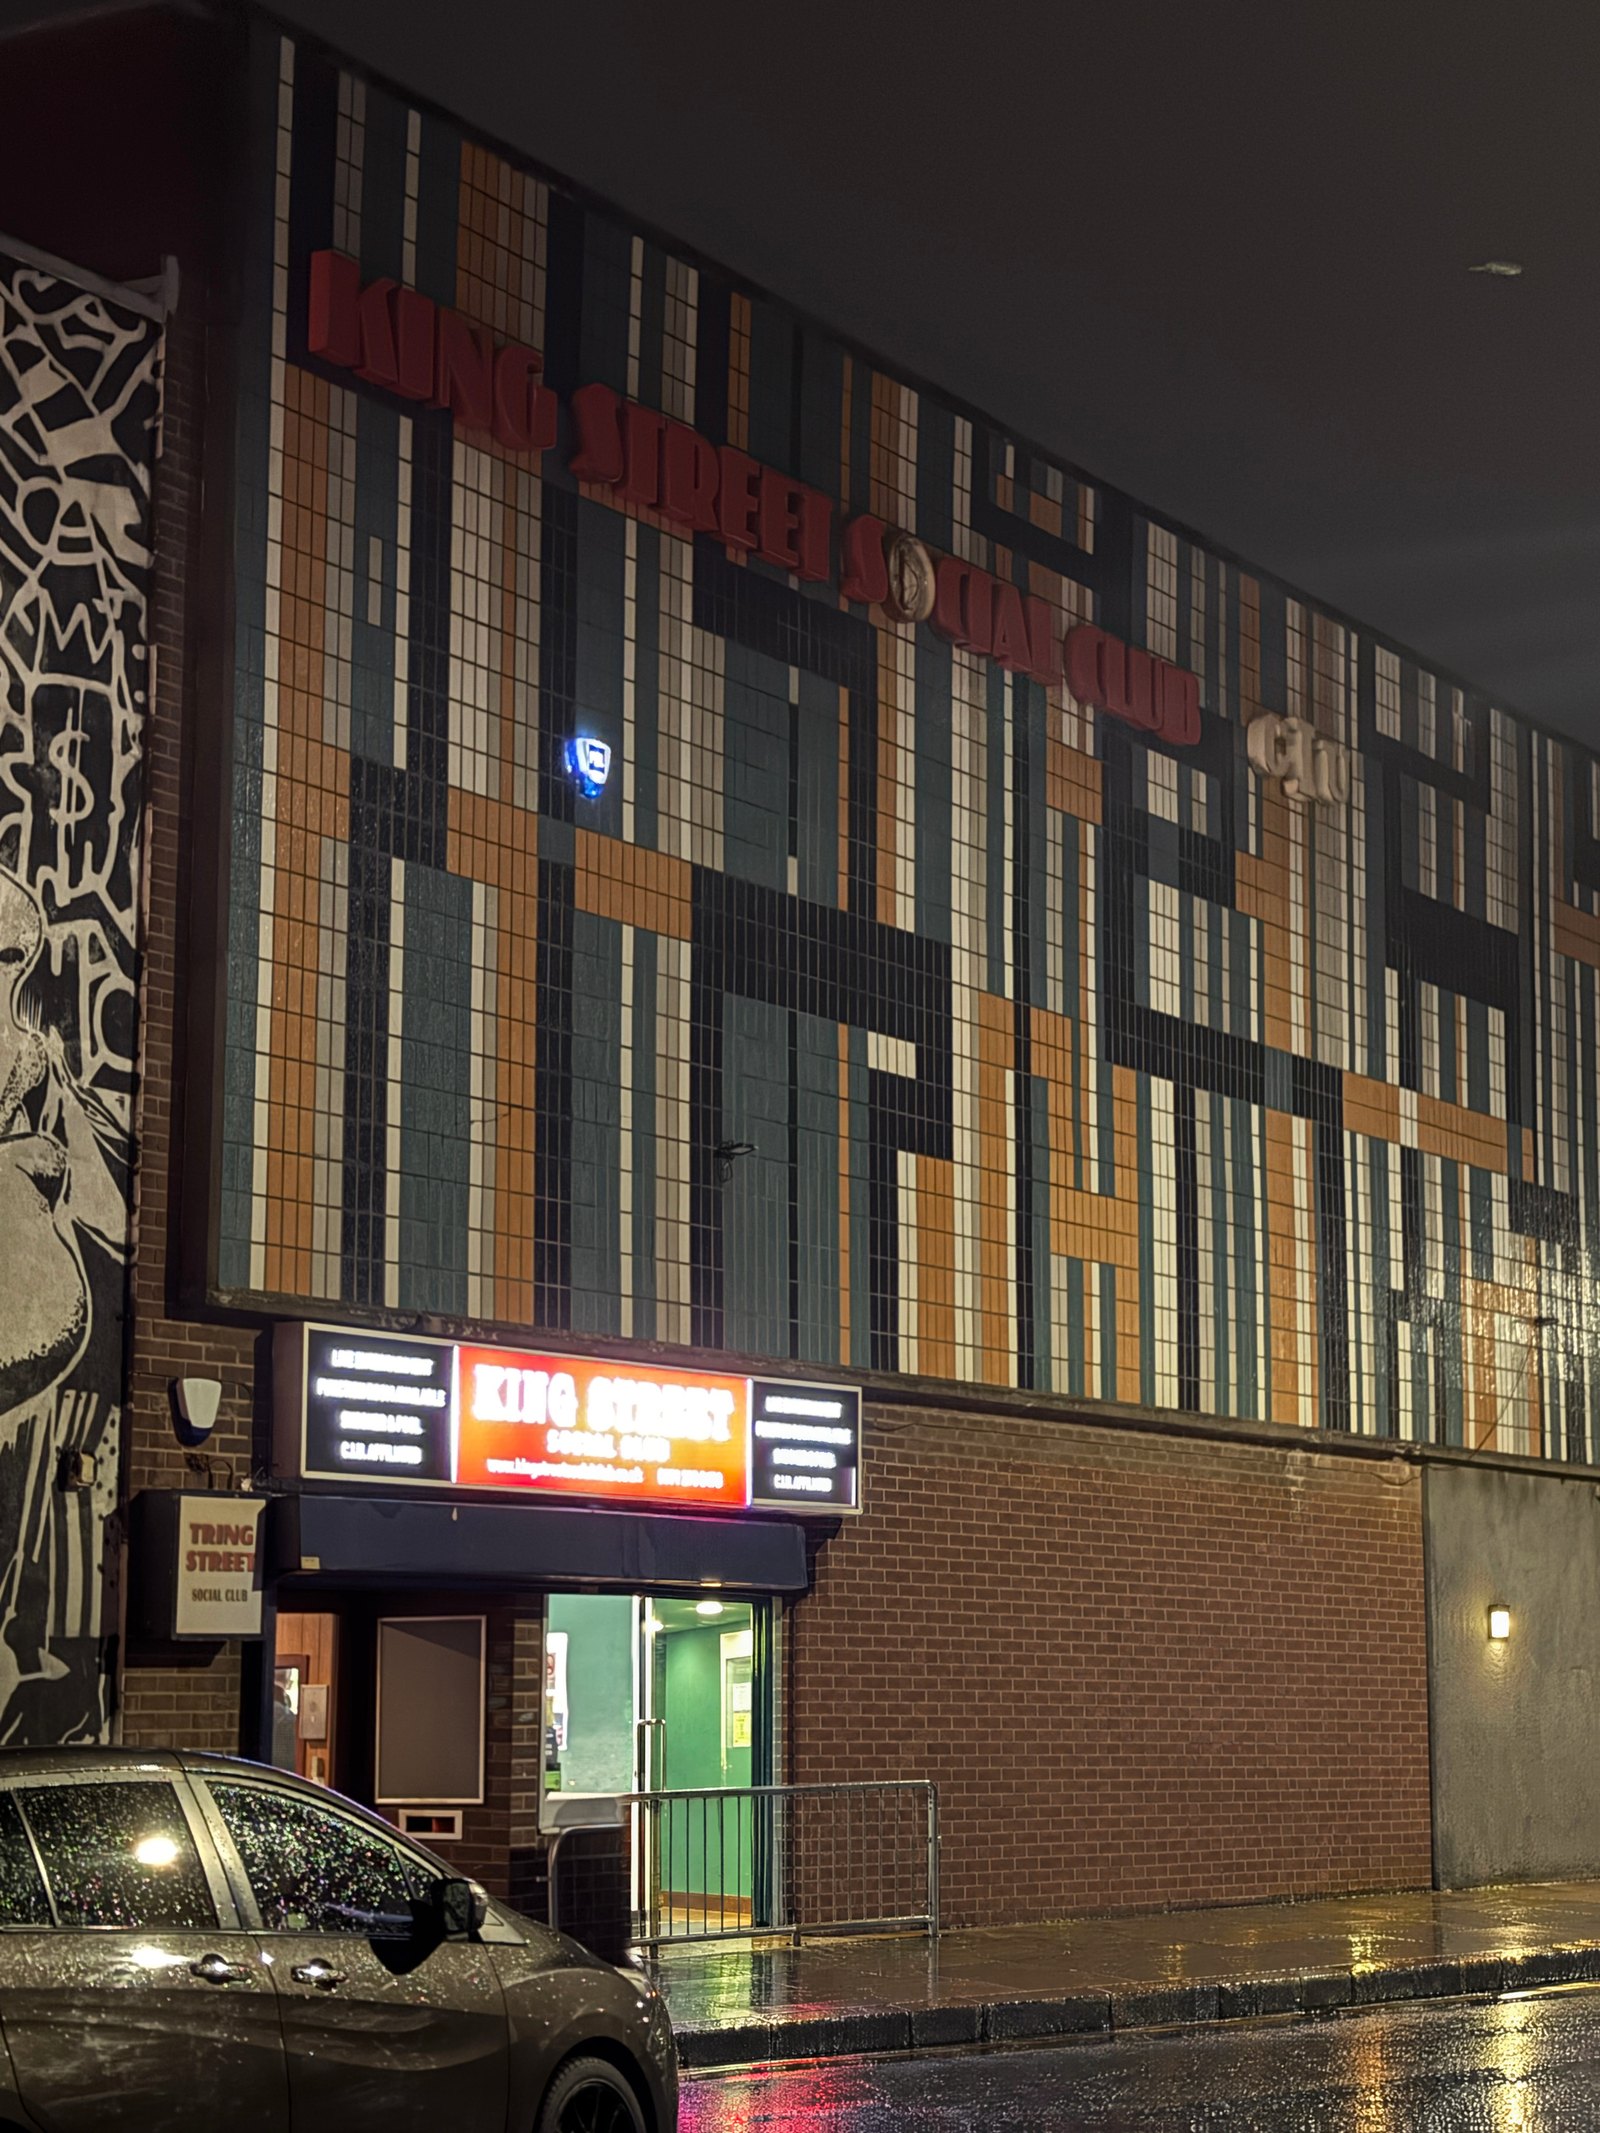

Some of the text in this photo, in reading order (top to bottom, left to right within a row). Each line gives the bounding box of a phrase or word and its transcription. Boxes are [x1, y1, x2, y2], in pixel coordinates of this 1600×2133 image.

[309, 249, 1201, 746] KING STREET SOCIAL CLUB
[472, 1364, 578, 1428] KING
[587, 1376, 735, 1442] STREET
[185, 1550, 256, 1573] STREET
[191, 1587, 248, 1602] SOCIAL CLUB
